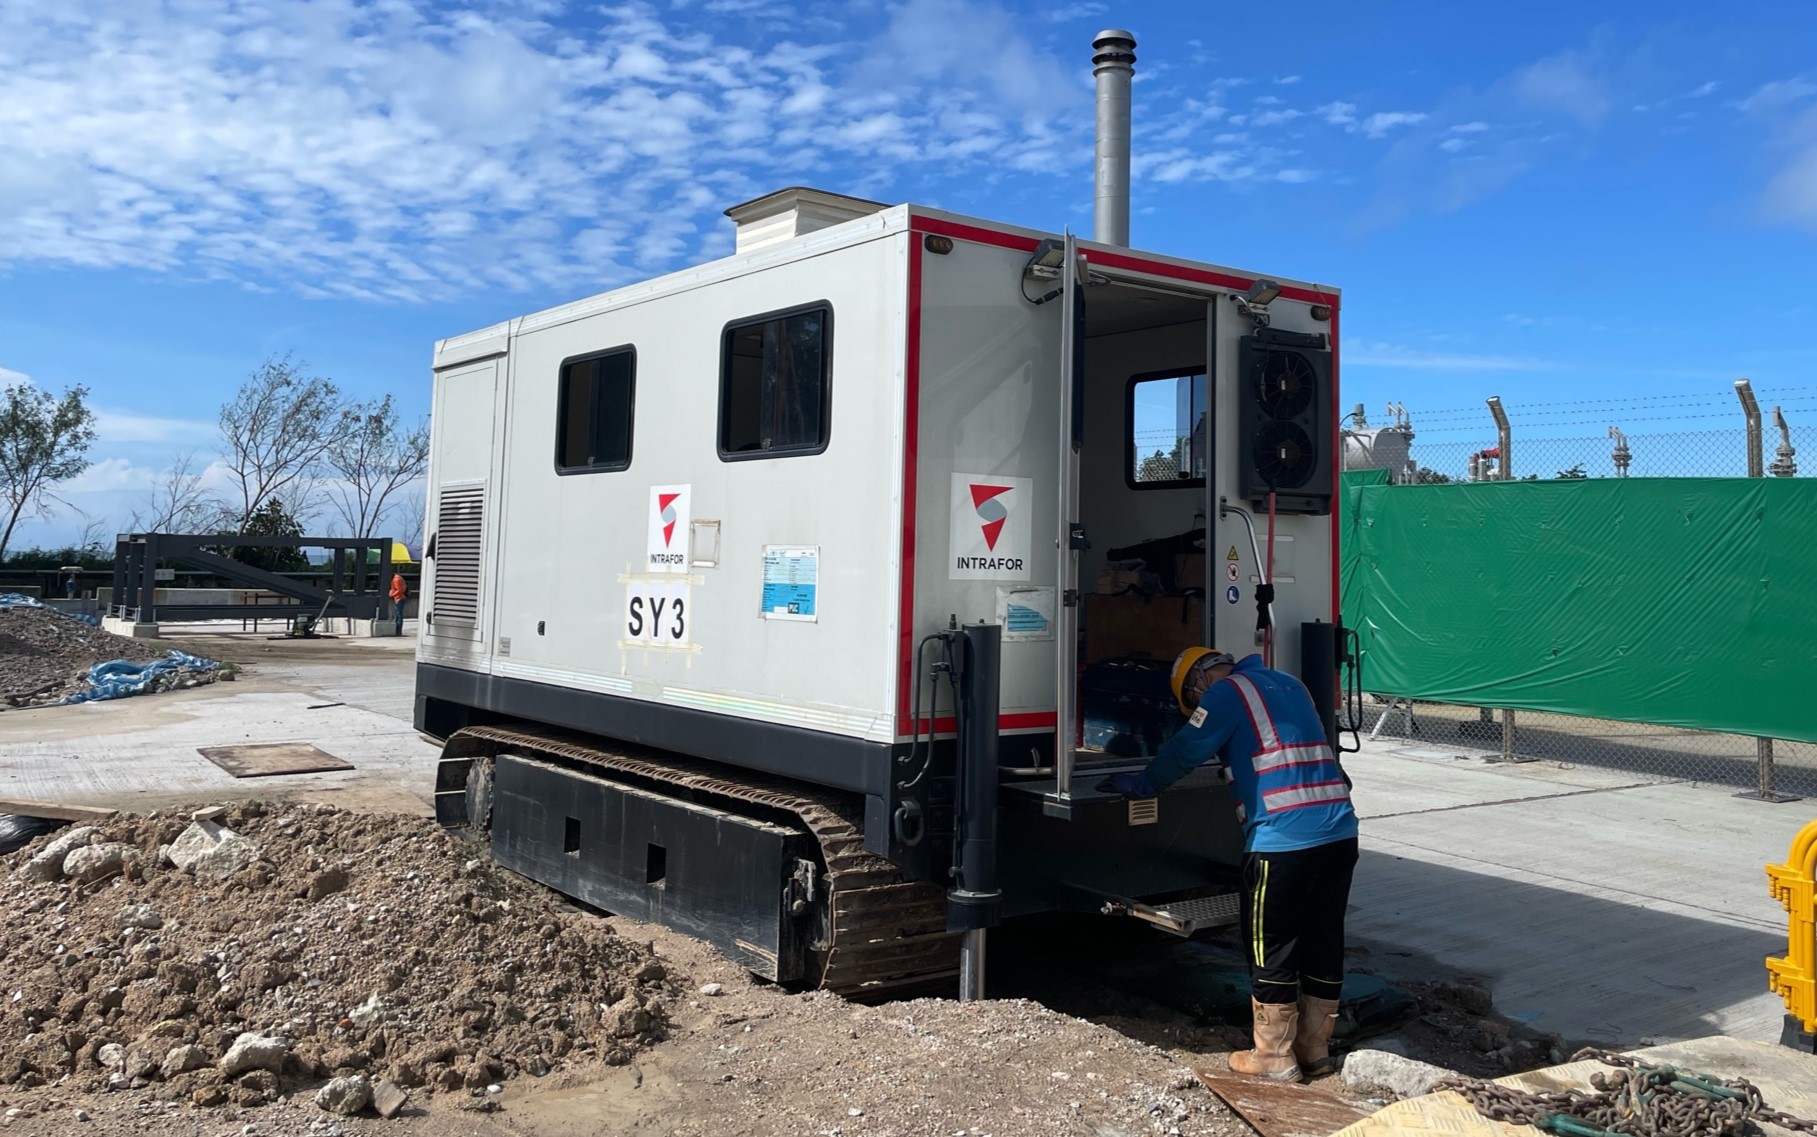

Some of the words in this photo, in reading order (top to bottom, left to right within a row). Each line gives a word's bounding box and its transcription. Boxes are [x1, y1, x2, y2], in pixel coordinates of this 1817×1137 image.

[650, 554, 684, 564] INTRAFOR
[957, 556, 1023, 570] INTRAFOR
[628, 596, 684, 639] SY3
